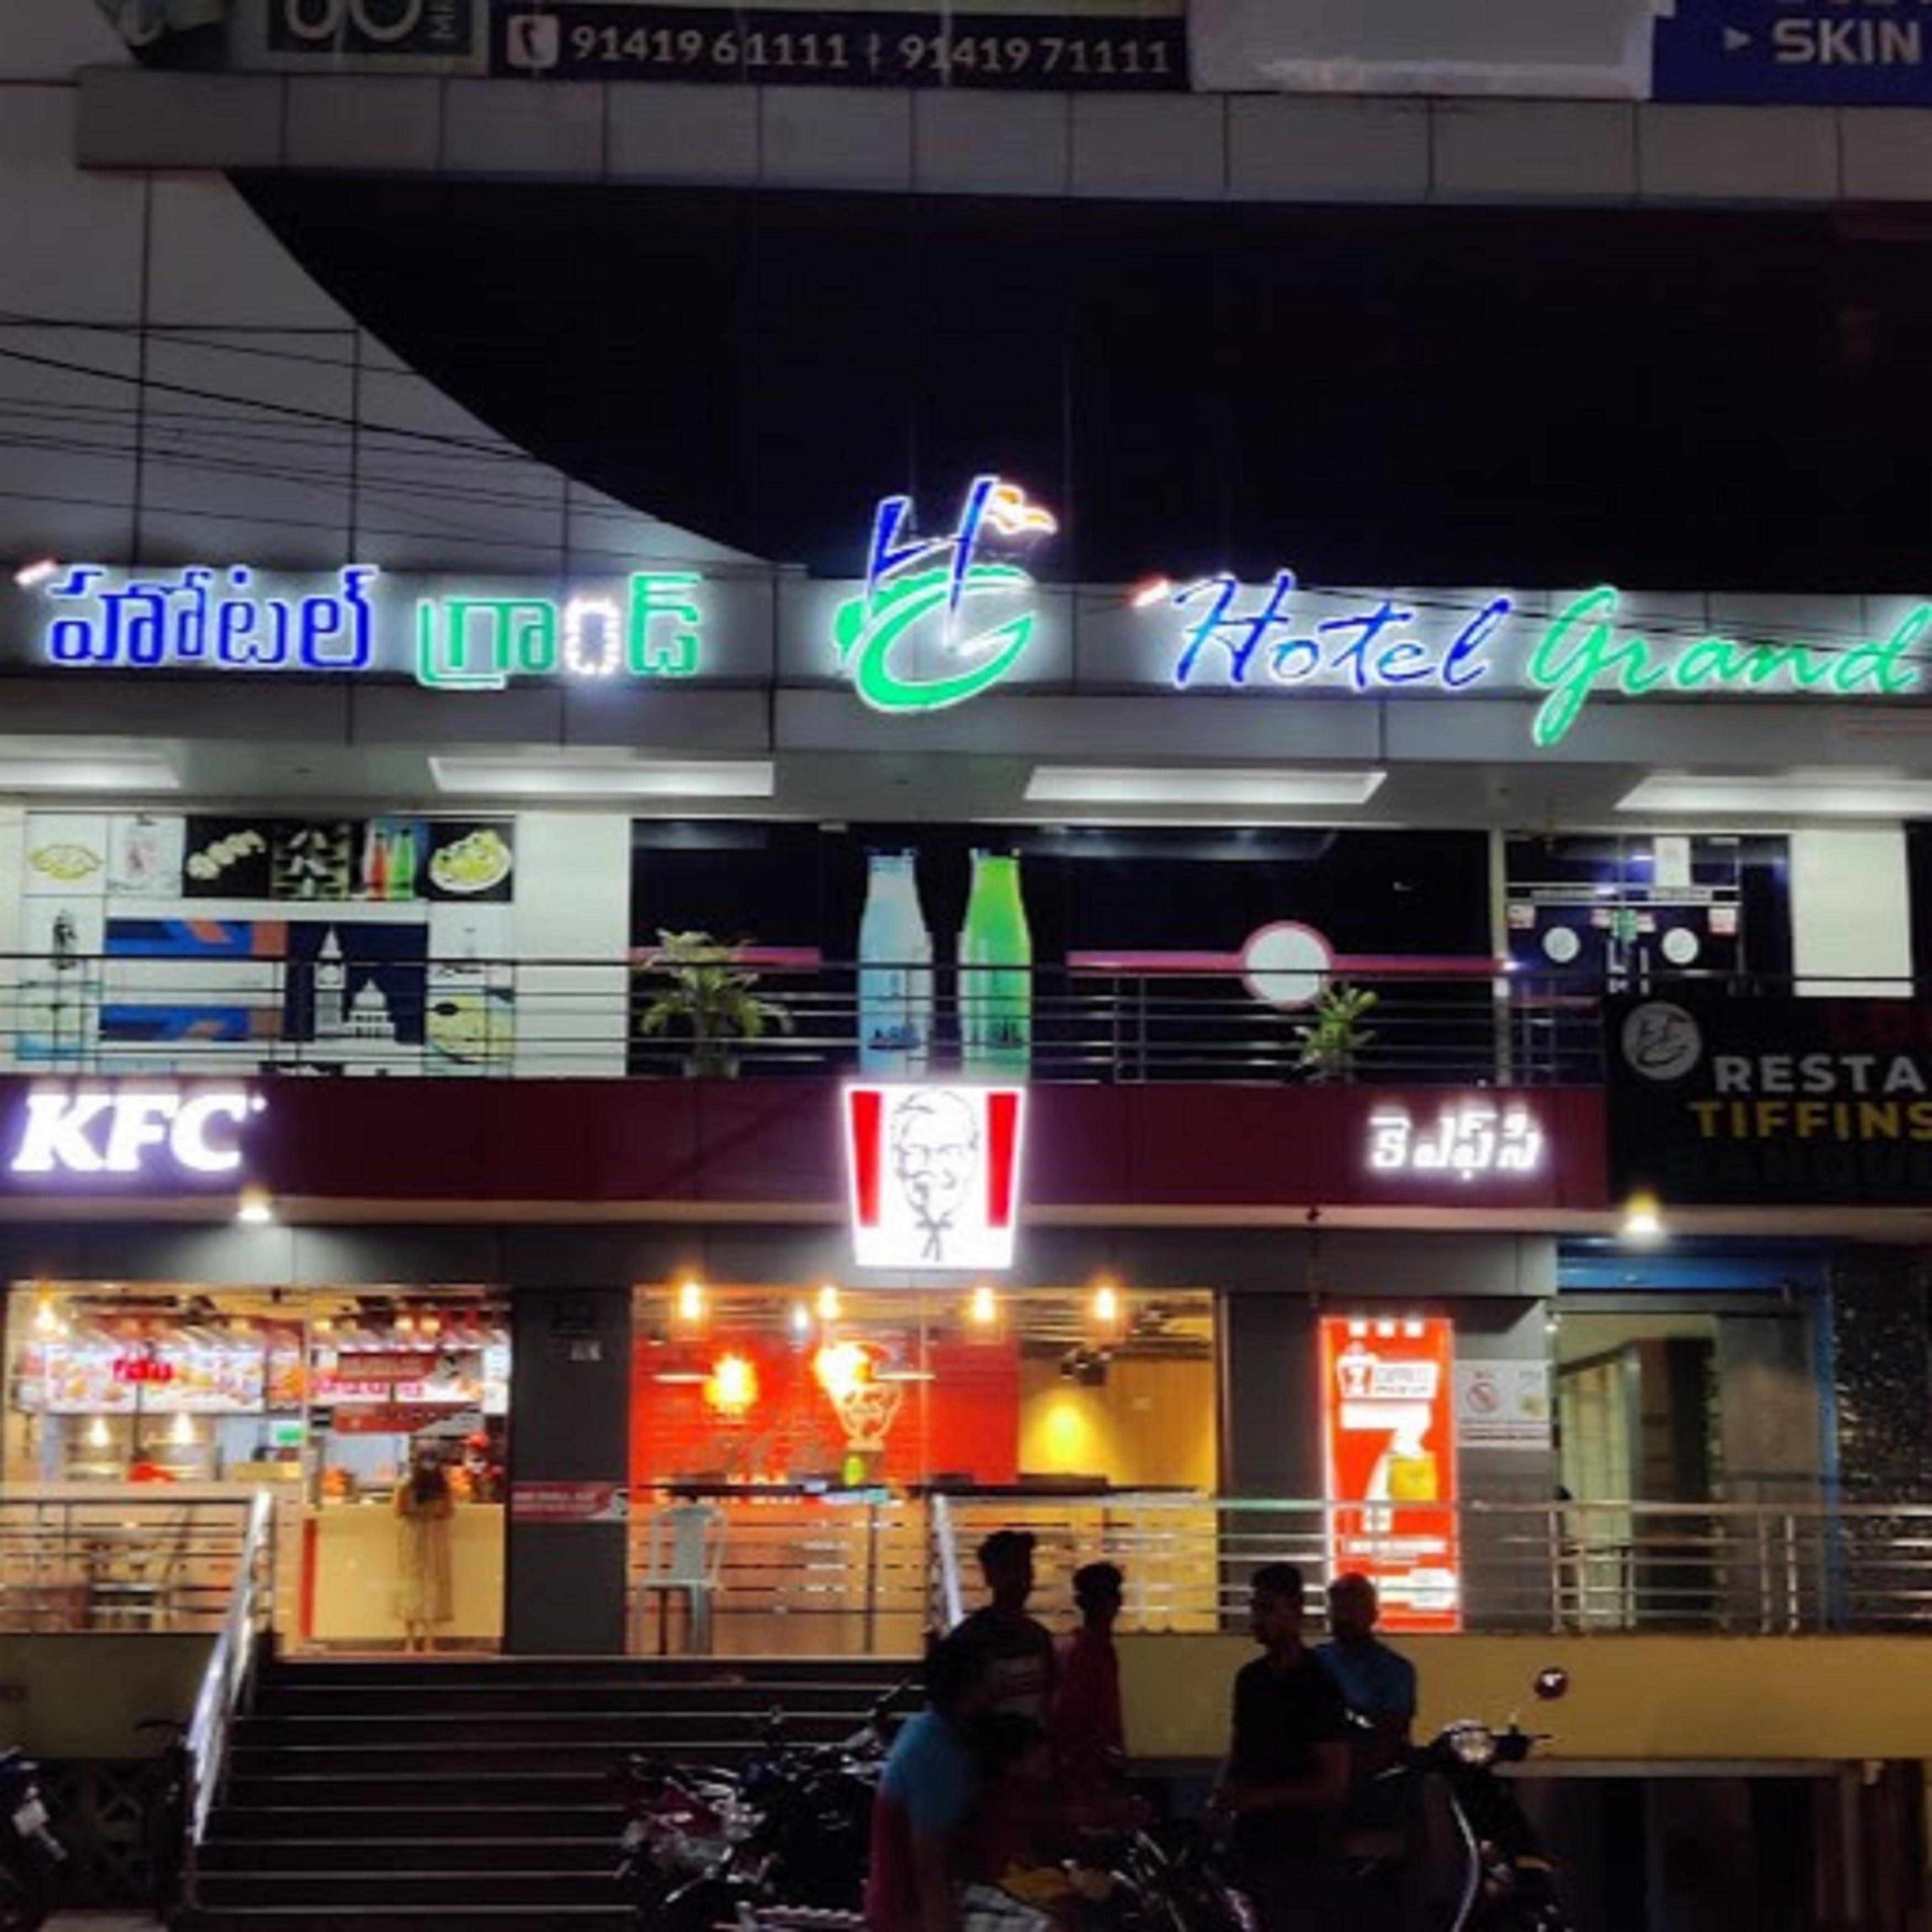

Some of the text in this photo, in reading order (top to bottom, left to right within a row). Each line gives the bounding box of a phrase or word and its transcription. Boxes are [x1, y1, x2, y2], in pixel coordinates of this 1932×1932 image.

[1772, 18, 1922, 65] SKIN
[47, 564, 380, 669] హోటల్
[1172, 569, 1932, 747] Hotel Grand
[1713, 1053, 1928, 1093] RESTA
[11, 1094, 248, 1171] KFC
[1686, 1100, 1932, 1142] TIFFINS
